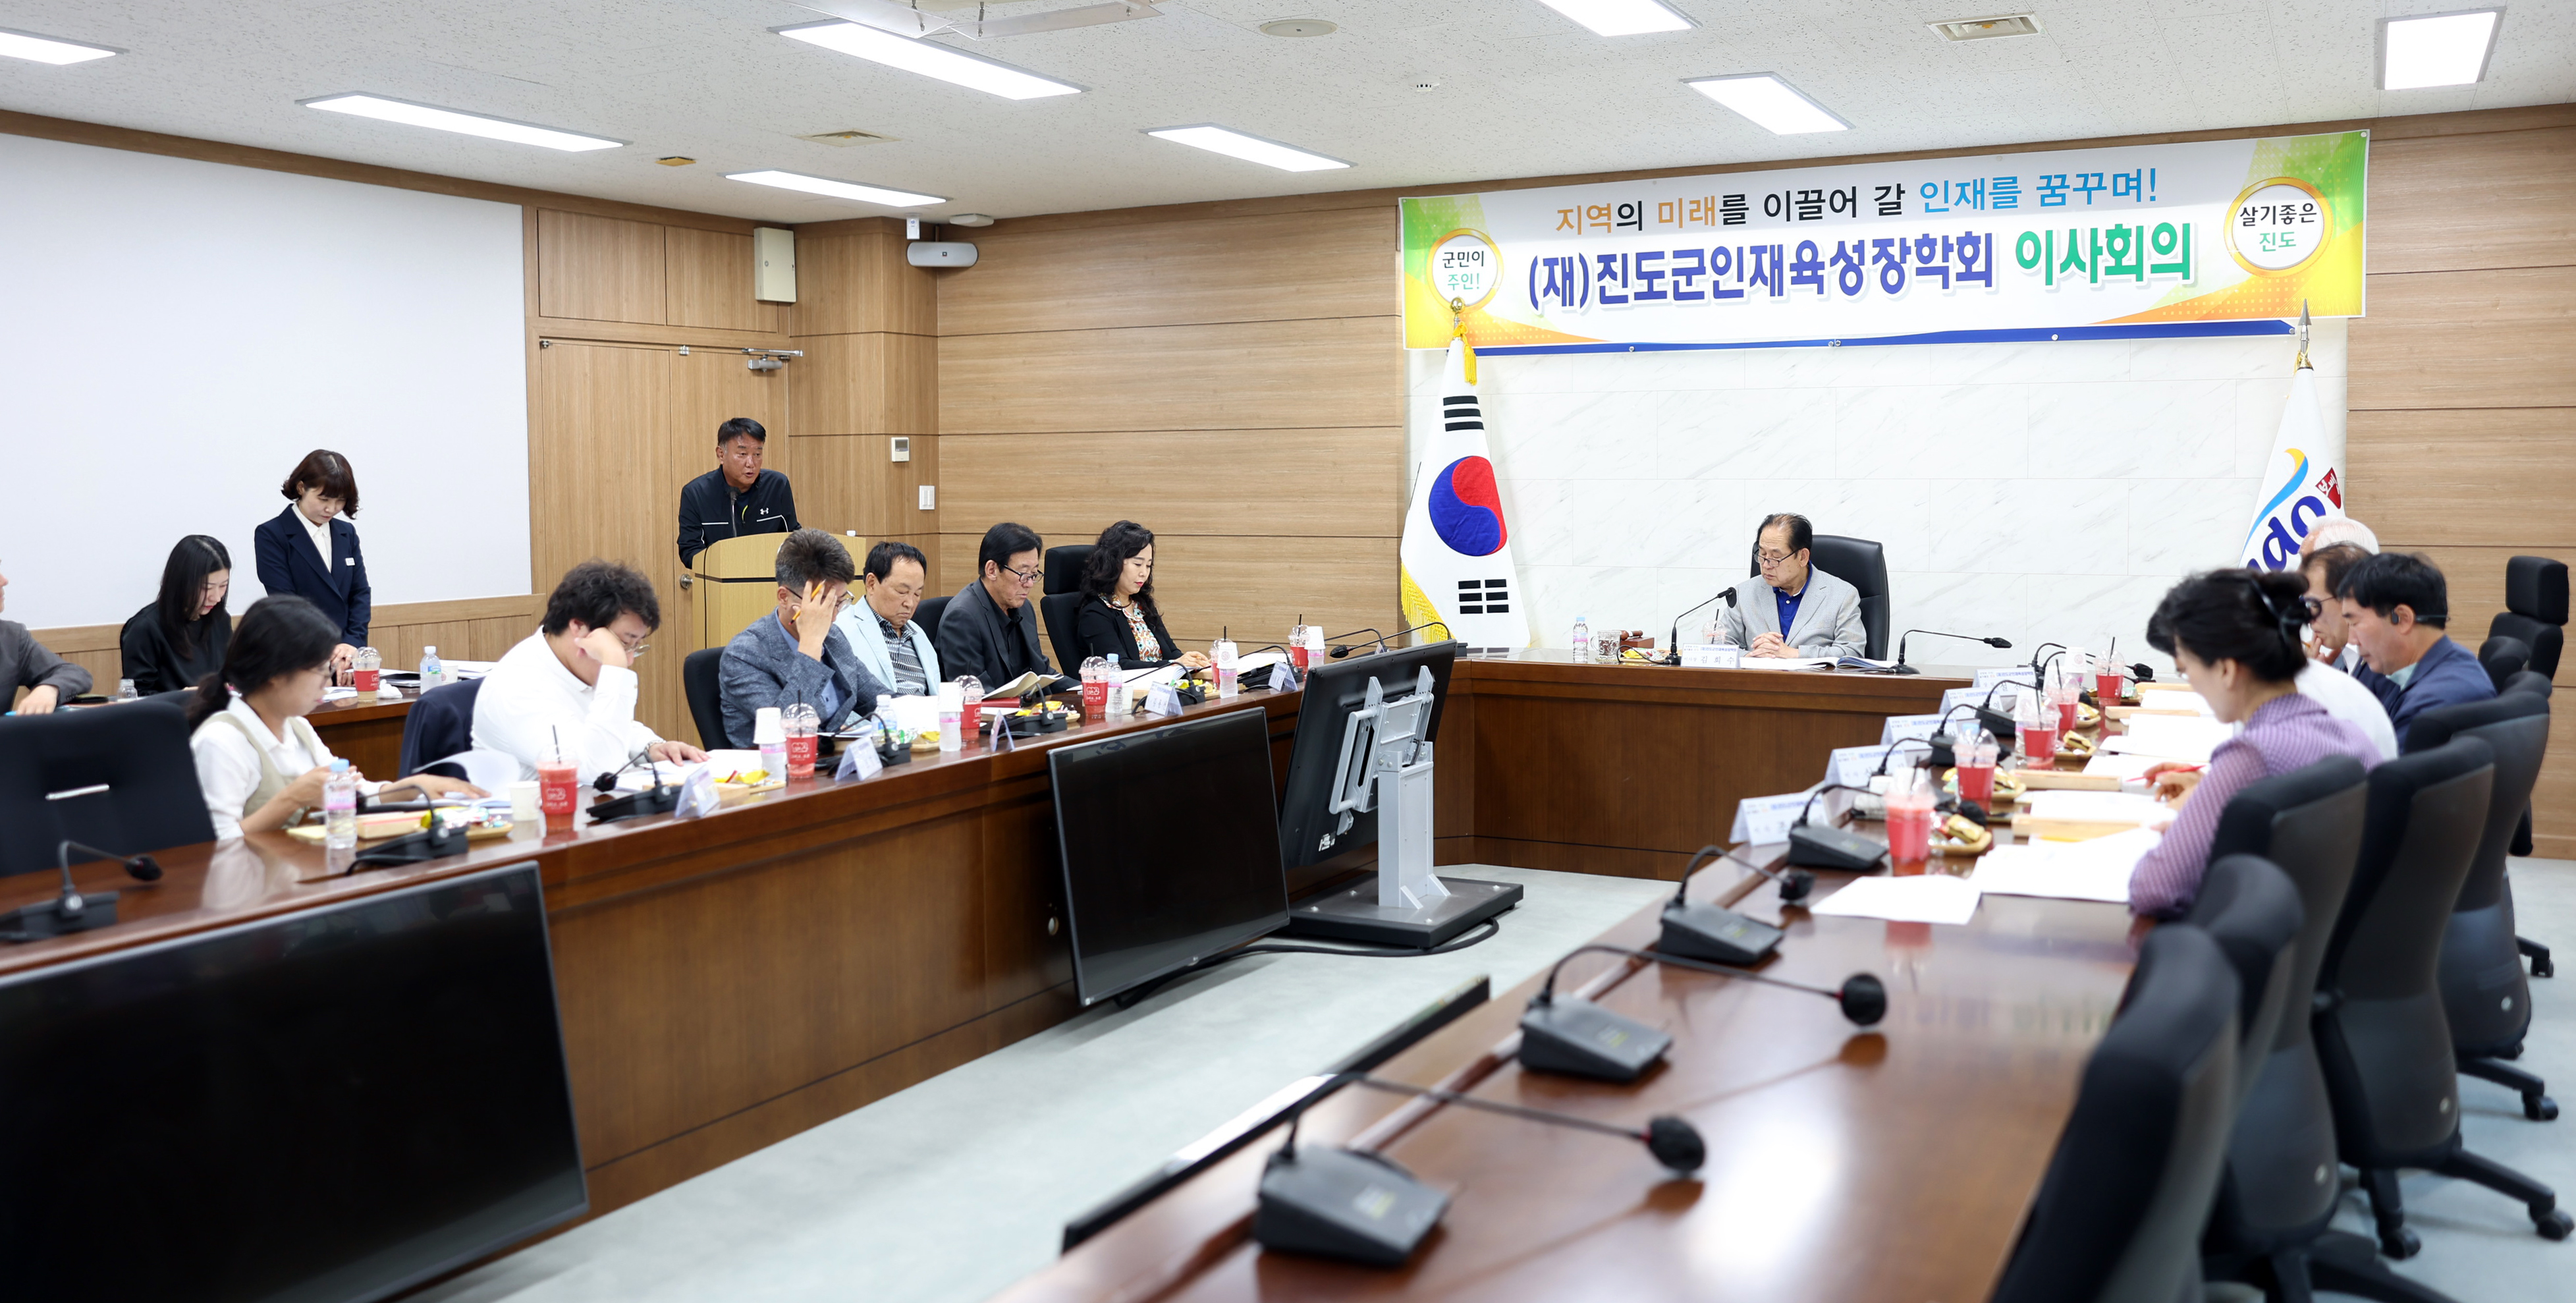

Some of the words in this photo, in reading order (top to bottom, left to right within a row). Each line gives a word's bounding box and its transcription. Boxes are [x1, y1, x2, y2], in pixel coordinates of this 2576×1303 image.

[1556, 200, 1643, 235] 지역의
[1658, 194, 1749, 228] 미래를
[1763, 186, 1857, 222] 이끌어
[1873, 183, 1905, 216] 갈
[1919, 175, 2023, 213] 인재를
[2035, 167, 2158, 208] 꿈꾸며!
[2239, 200, 2318, 228] 살기좋은
[2259, 231, 2297, 253] 진도
[1442, 250, 1485, 269] 군민이
[1529, 230, 1994, 310] (재)진도군인재육성장학회
[2015, 221, 2191, 286] 이사회의
[1447, 273, 1480, 291] 주인!
[2245, 495, 2327, 574] do
